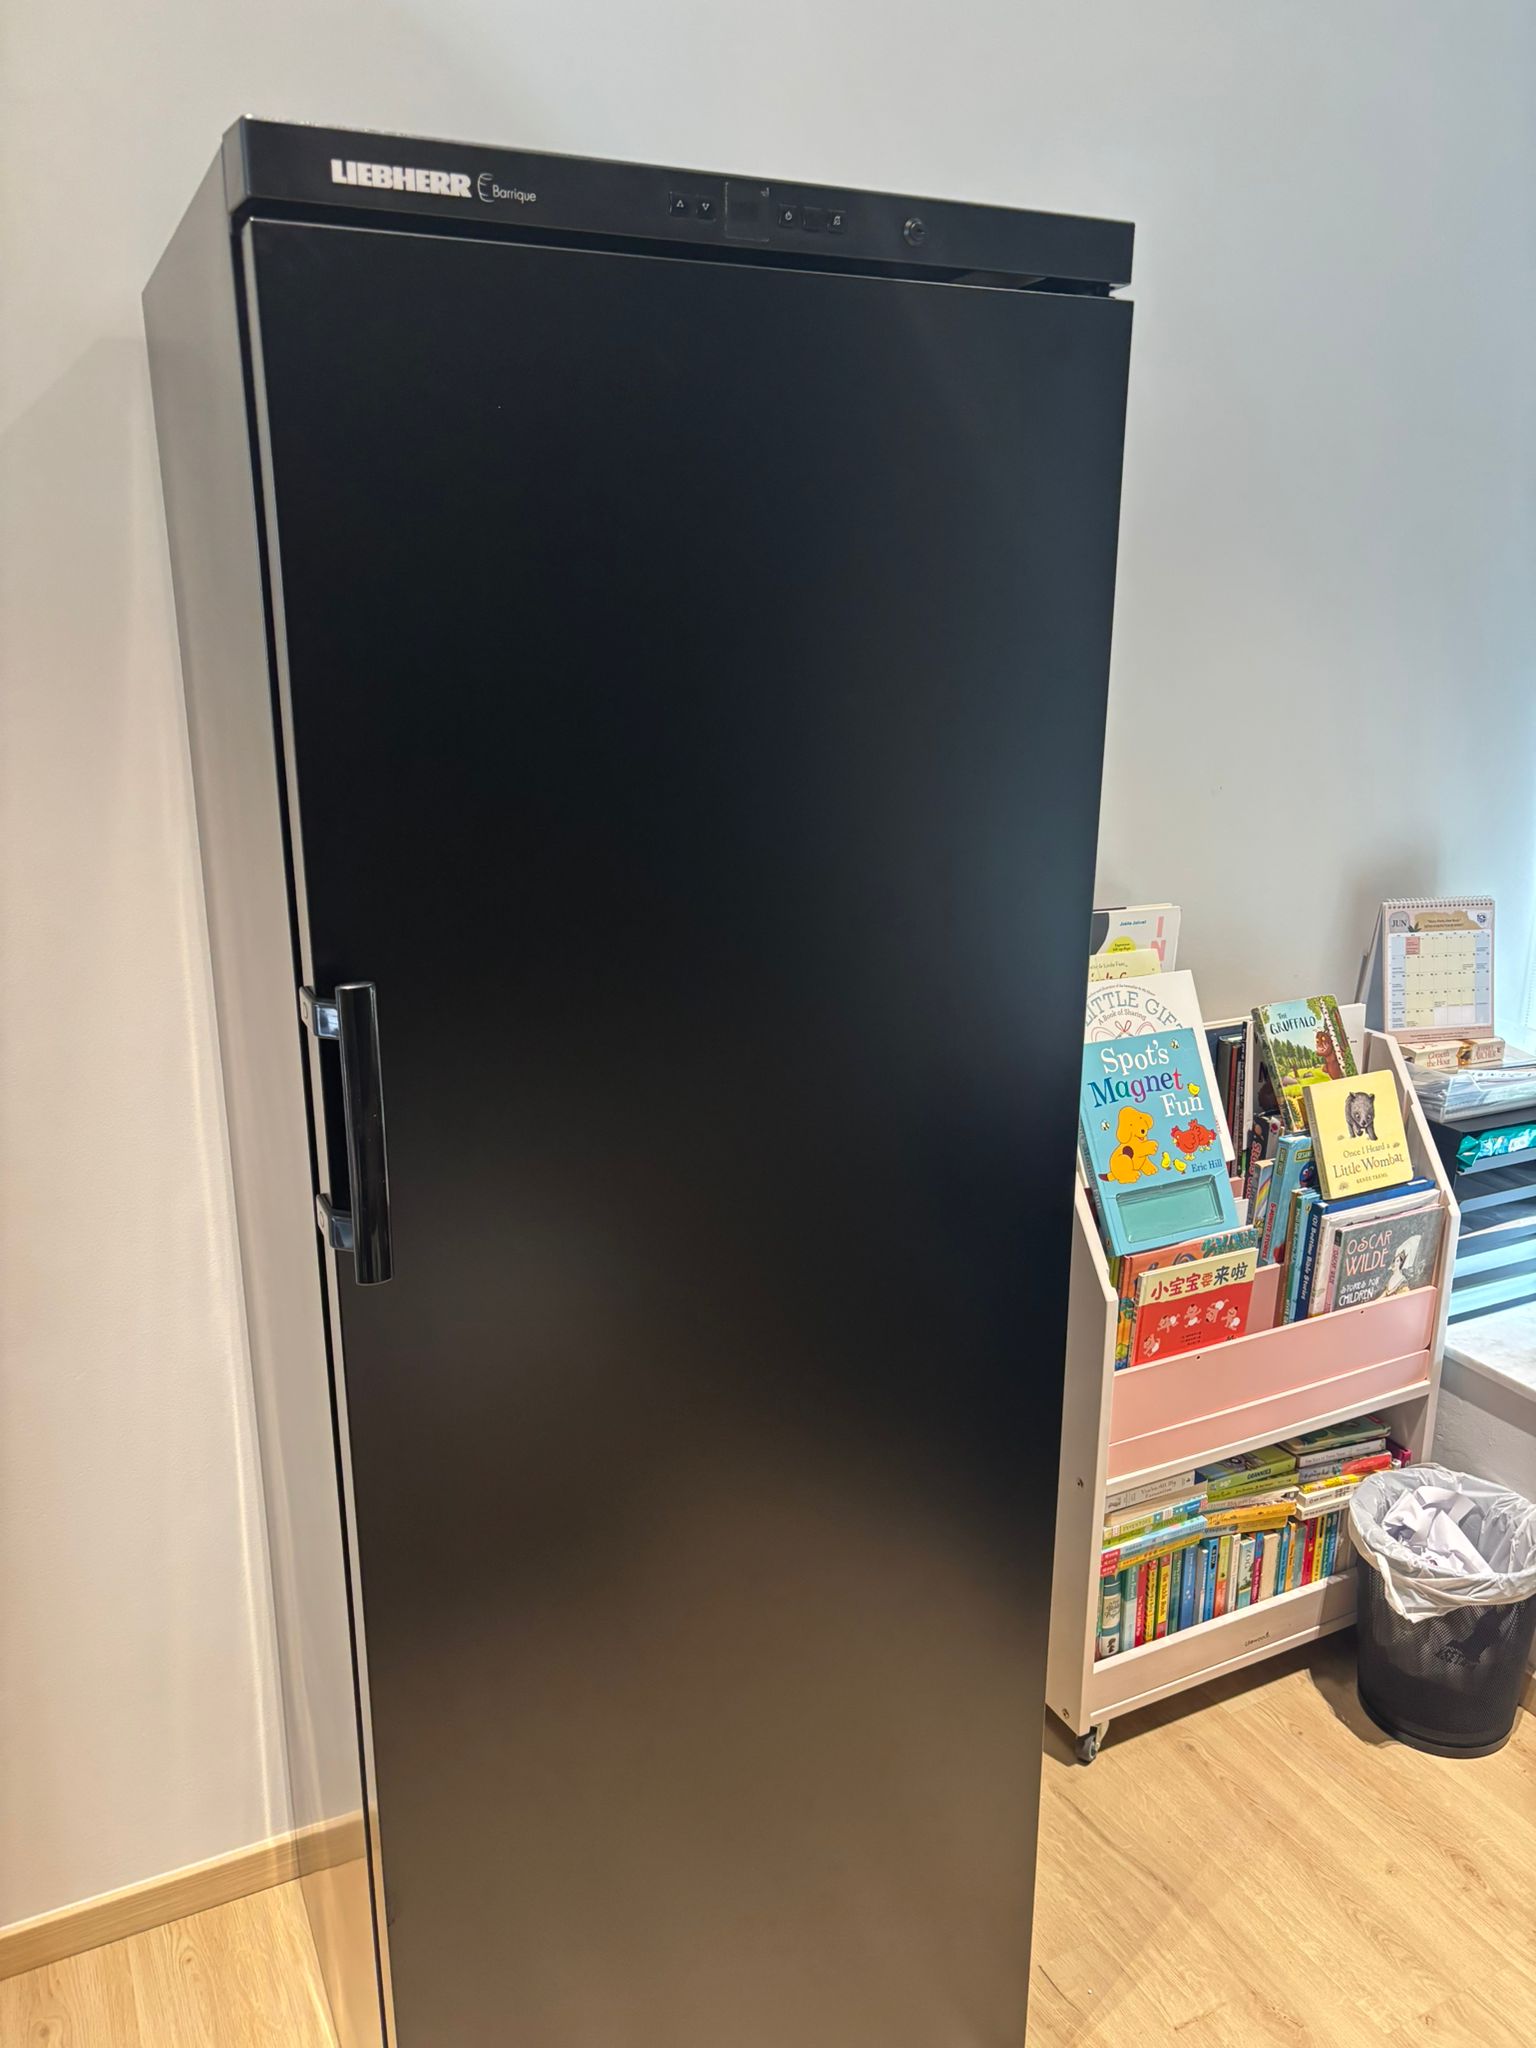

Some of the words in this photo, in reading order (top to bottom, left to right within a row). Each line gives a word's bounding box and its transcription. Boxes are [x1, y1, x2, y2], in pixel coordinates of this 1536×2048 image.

[330, 158, 472, 198] LIEBHERR
[492, 185, 537, 203] Barrique
[1392, 919, 1408, 928] JUN
[1102, 1010, 1117, 1019] Book
[1124, 1009, 1147, 1021] Sharing
[1145, 998, 1183, 1028] GIF
[1270, 1016, 1316, 1035] GRUFFALO
[1100, 1040, 1170, 1075] Spot's
[1088, 1067, 1184, 1108] Magnet
[1160, 1092, 1204, 1117] Fun
[1343, 1150, 1361, 1158] Once
[1366, 1142, 1385, 1154] Heard
[1191, 1162, 1207, 1173] Eric
[1208, 1158, 1223, 1170] Hill
[1333, 1162, 1361, 1178] Little
[1361, 1153, 1405, 1170] Wombat
[1306, 1226, 1316, 1255] Bedtime
[1347, 1230, 1393, 1254] OSCAR
[1304, 1255, 1312, 1274] Bible
[1346, 1248, 1389, 1276] WILDE
[1151, 1262, 1248, 1300] 小宝宝要来啦
[1300, 1274, 1310, 1300] Stories
[1339, 1287, 1375, 1306] CHILDREN
